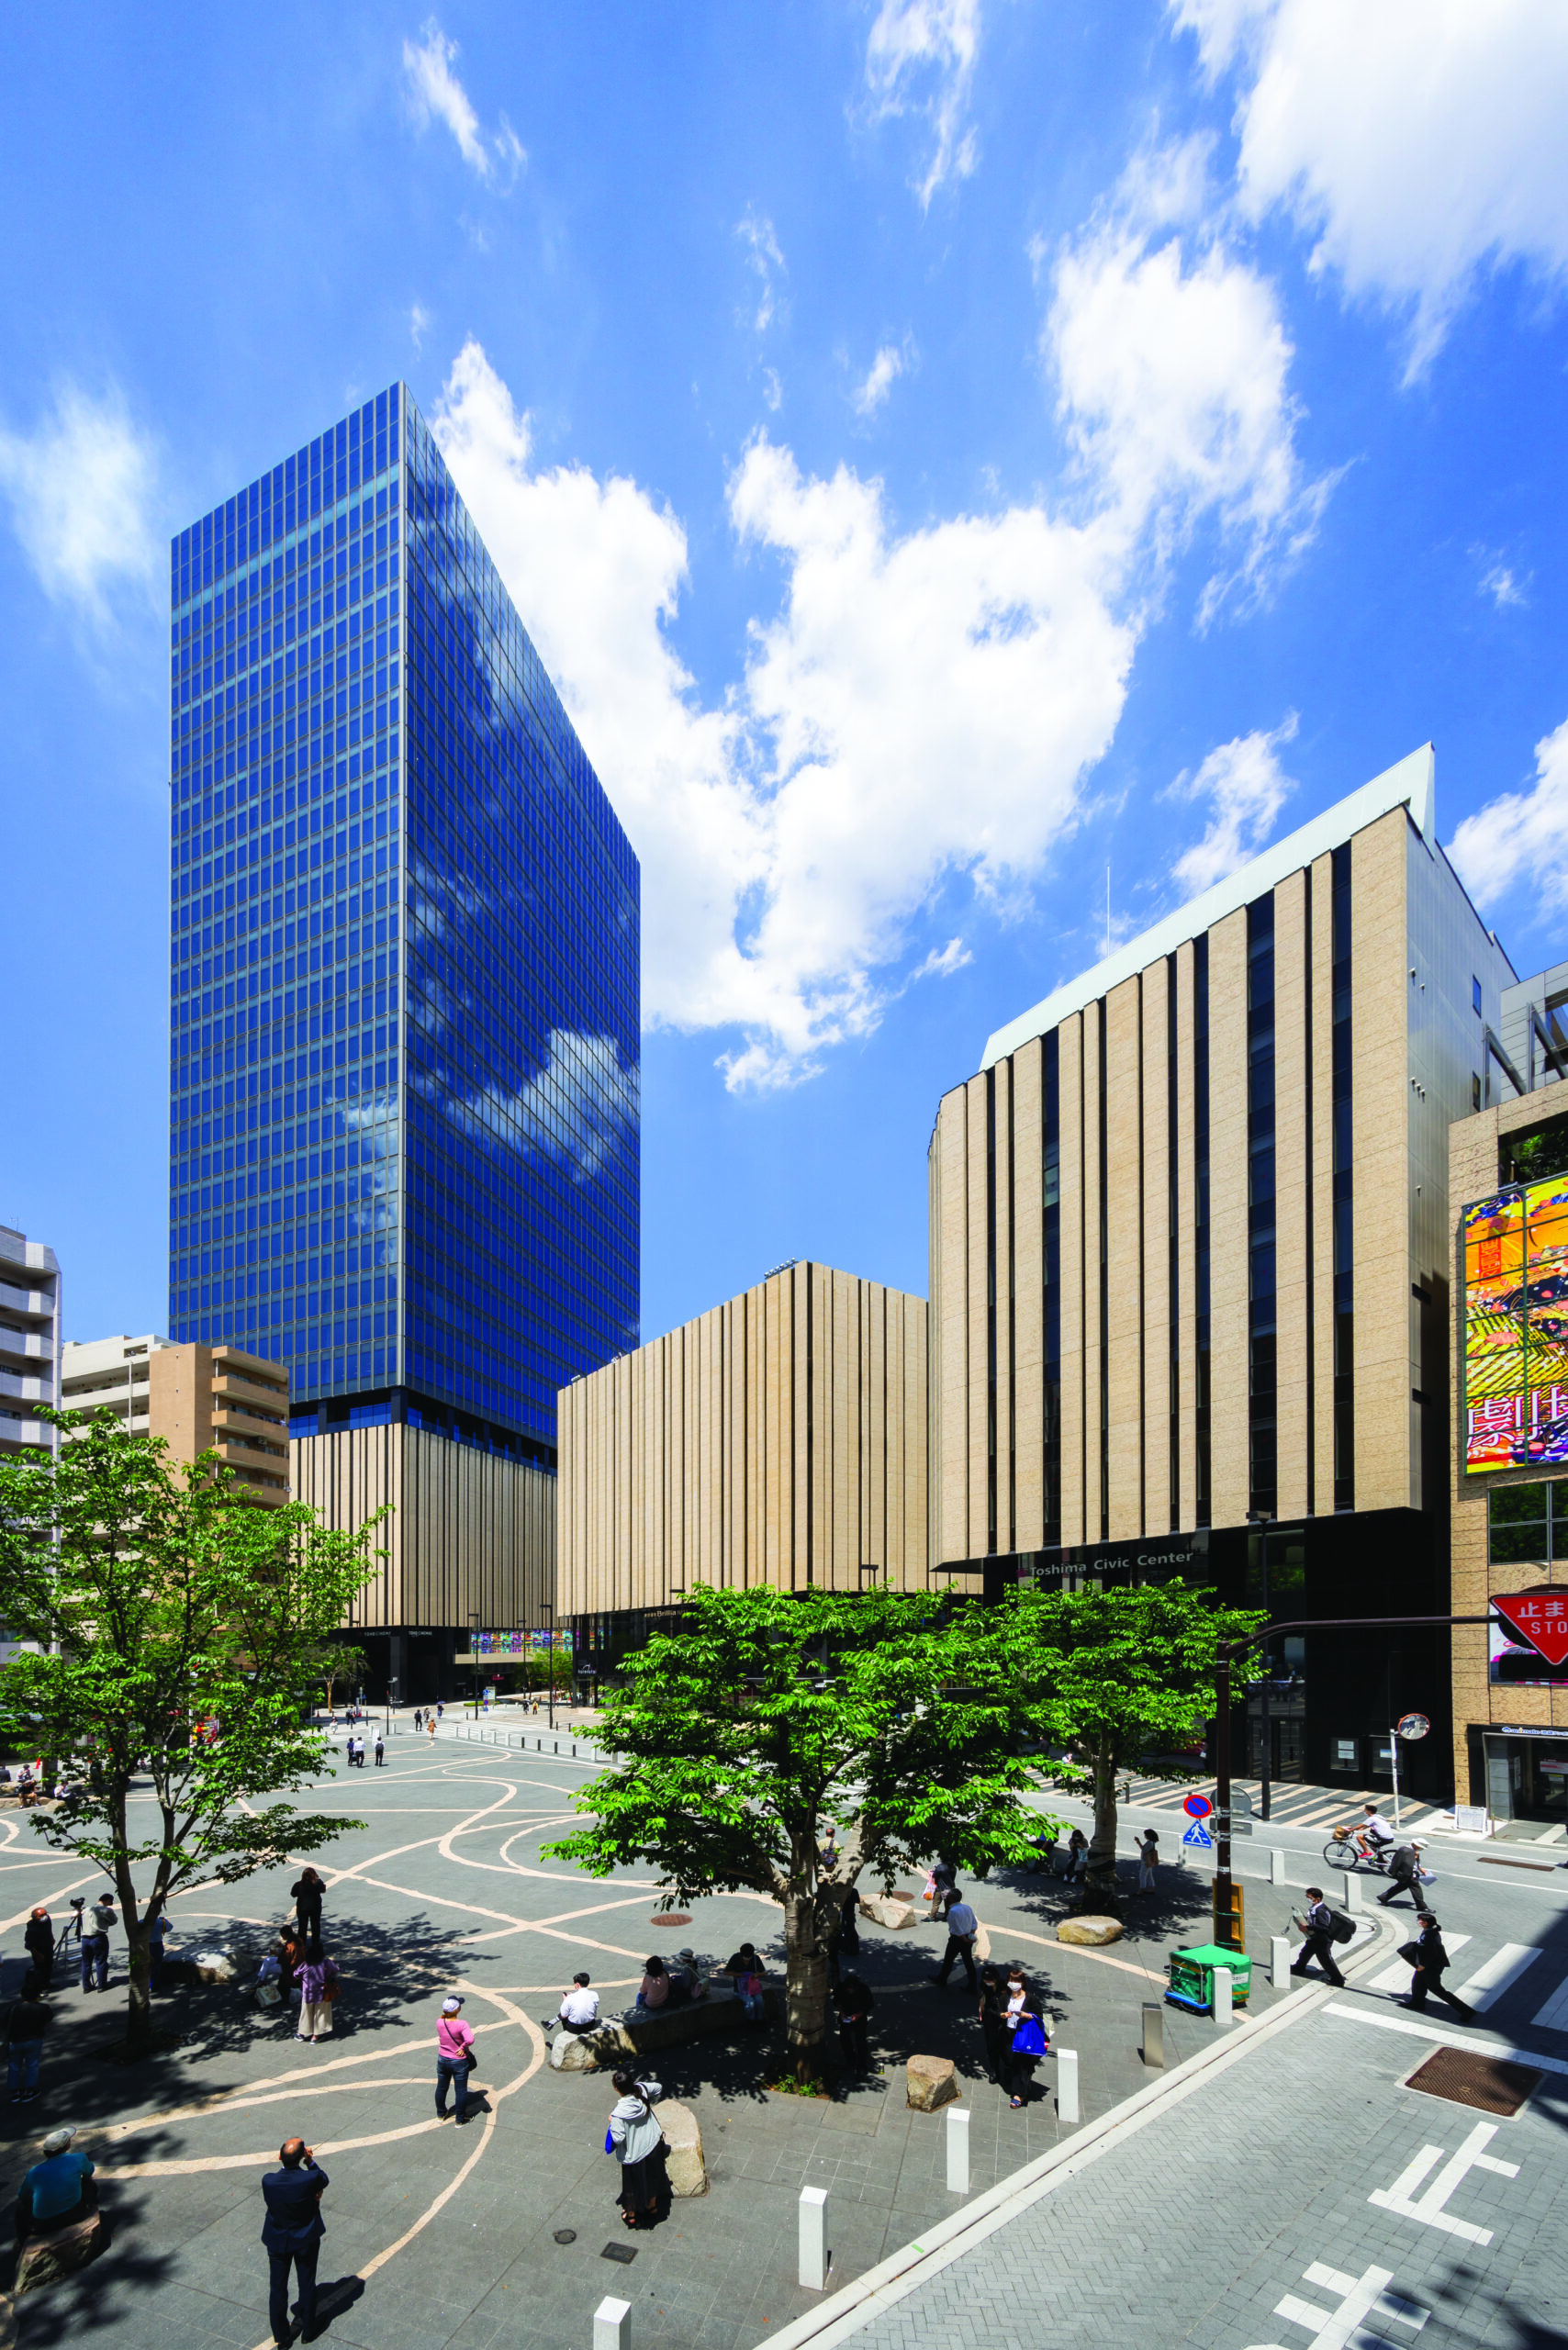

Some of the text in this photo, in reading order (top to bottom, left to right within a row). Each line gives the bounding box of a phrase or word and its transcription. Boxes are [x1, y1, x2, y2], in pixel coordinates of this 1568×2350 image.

[1030, 1551, 1193, 1576] Toshima Civic Center
